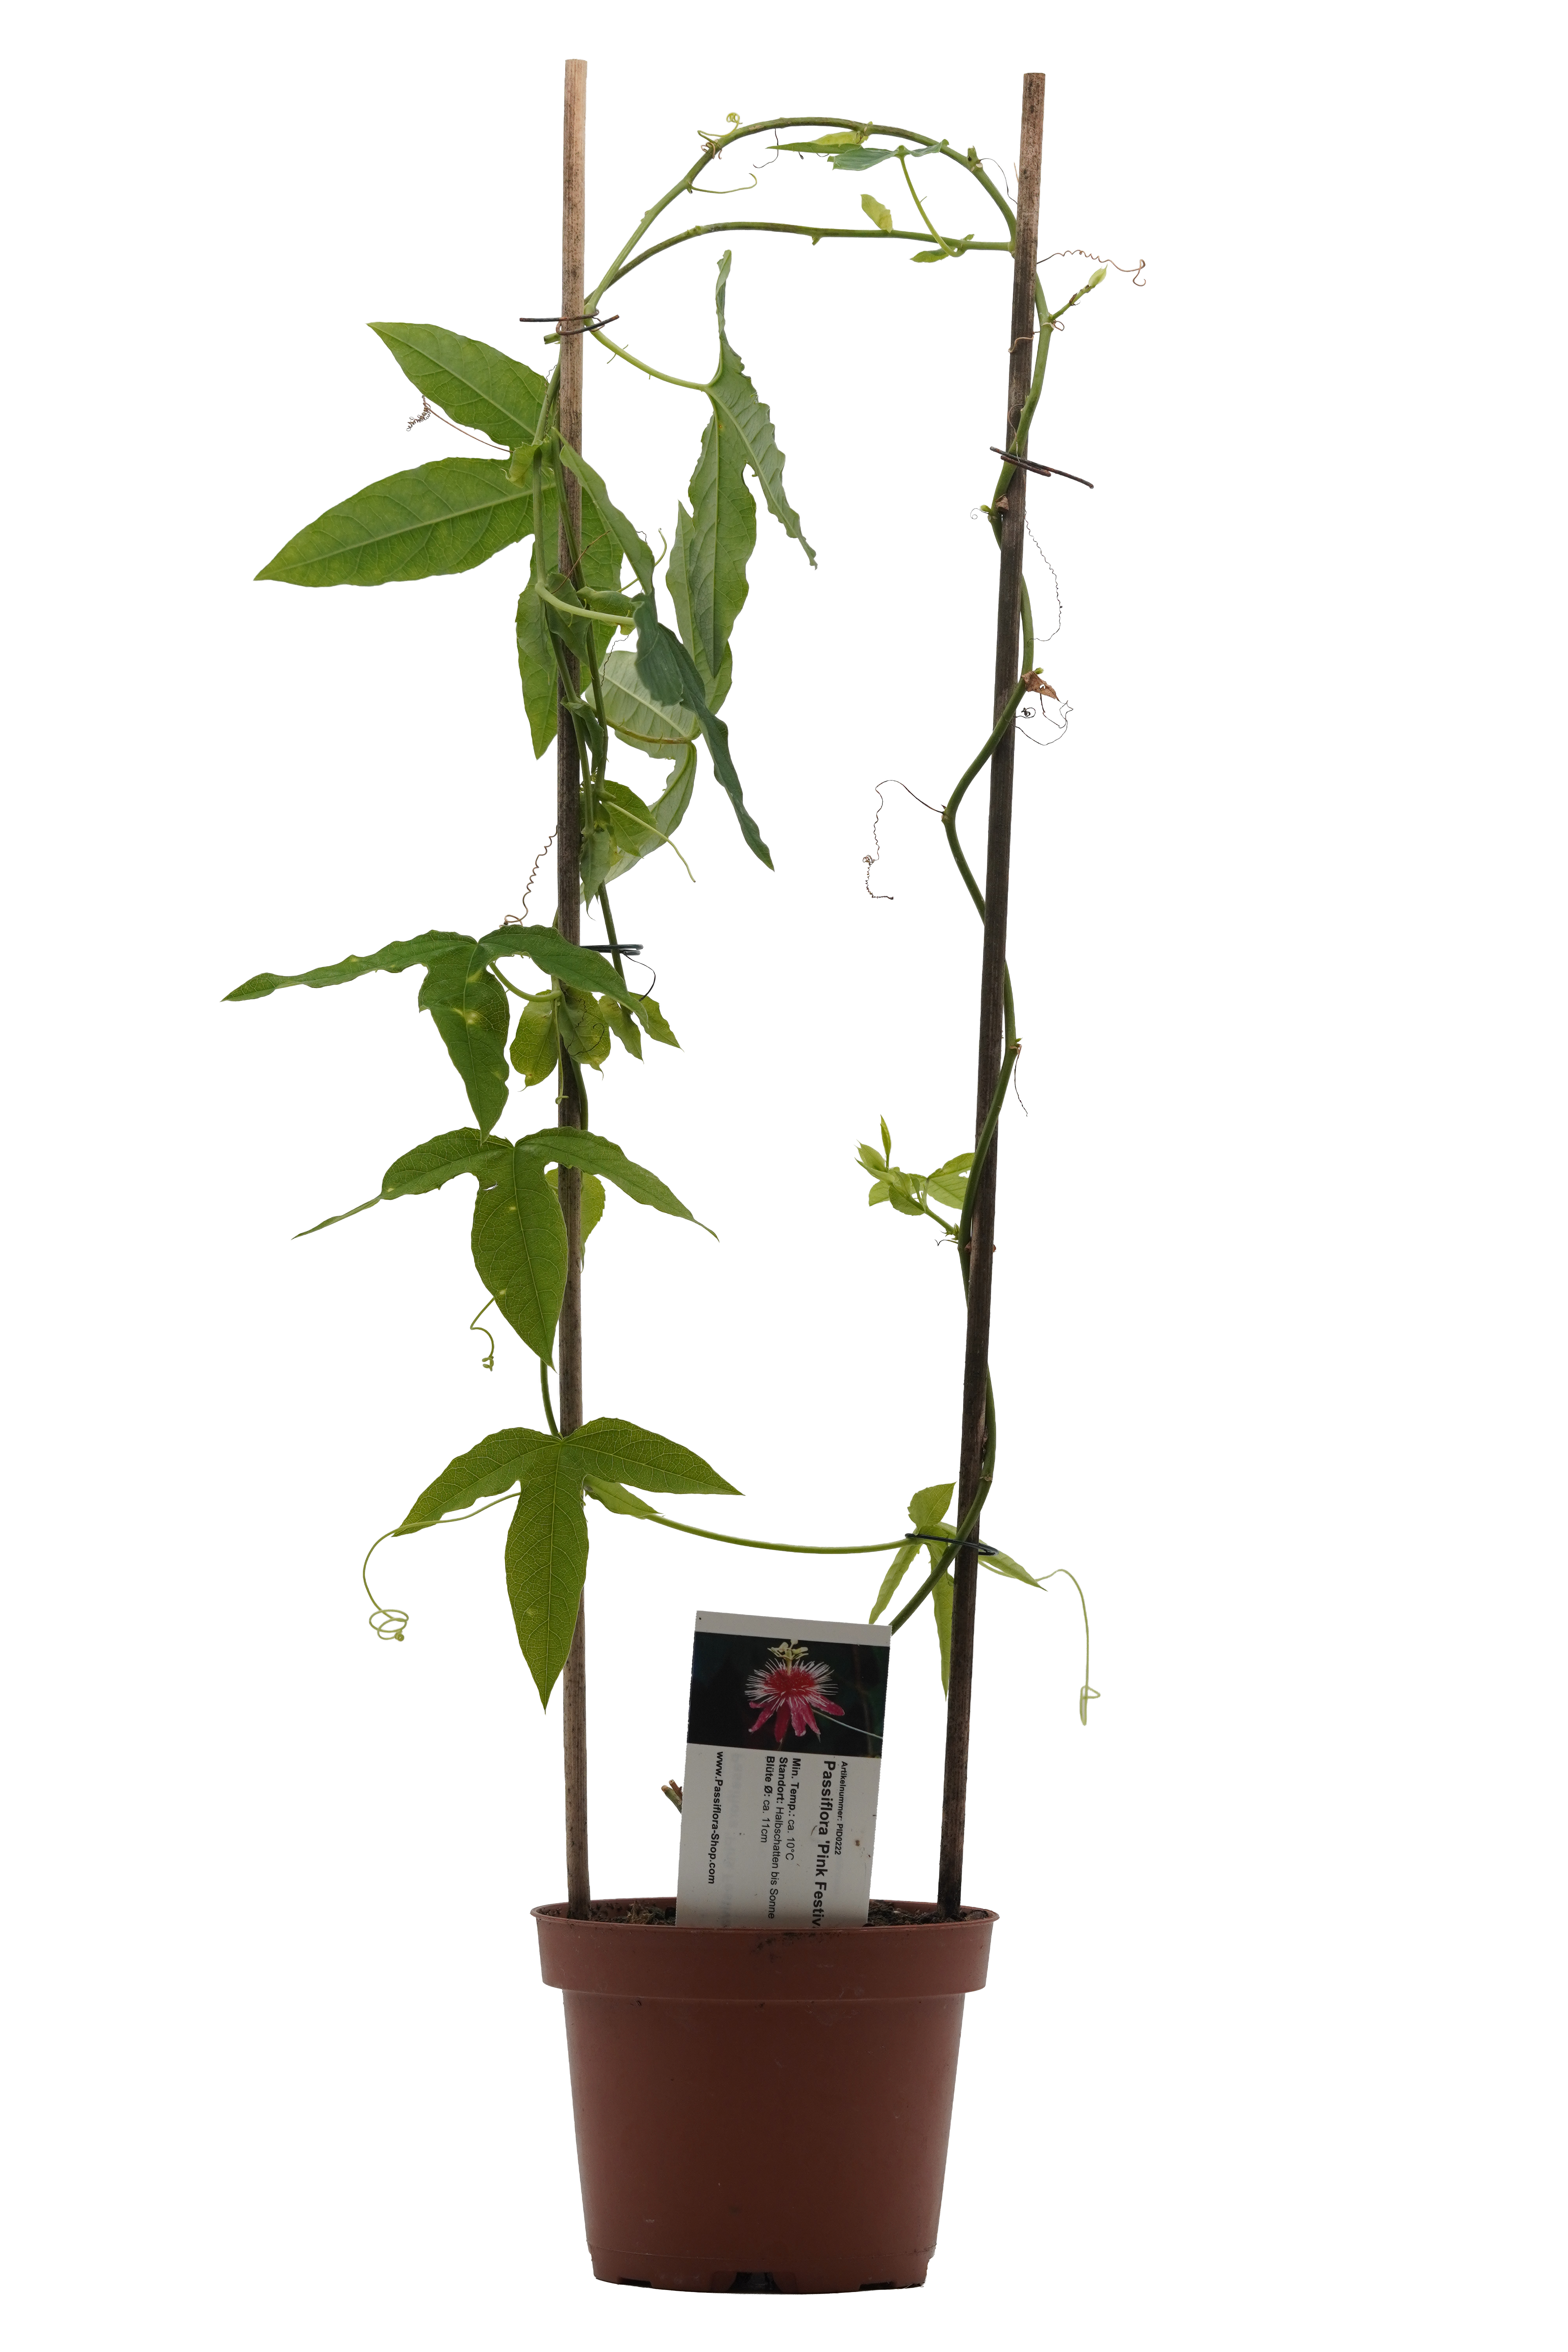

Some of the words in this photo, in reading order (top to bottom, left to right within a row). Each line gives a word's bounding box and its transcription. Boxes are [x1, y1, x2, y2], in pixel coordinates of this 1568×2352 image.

[765, 1756, 775, 1782] Blüte
[777, 1757, 788, 1803] Standort:
[791, 1758, 801, 1779] Min.
[788, 1782, 799, 1816] Temp.:
[819, 1761, 836, 1835] Passiflora
[837, 1761, 848, 1820] Artikelnummer:
[708, 1751, 723, 1884] www.Passiflora-Shop.com
[761, 1818, 770, 1842] 11cm
[772, 1807, 784, 1868] Halbschatten
[786, 1838, 795, 1860] 10°C
[835, 1824, 843, 1855] PID0222
[816, 1841, 830, 1877] 'Pink
[771, 1872, 779, 1885] bis
[768, 1889, 778, 1918] Sonne
[812, 1882, 827, 1928] Festiv
